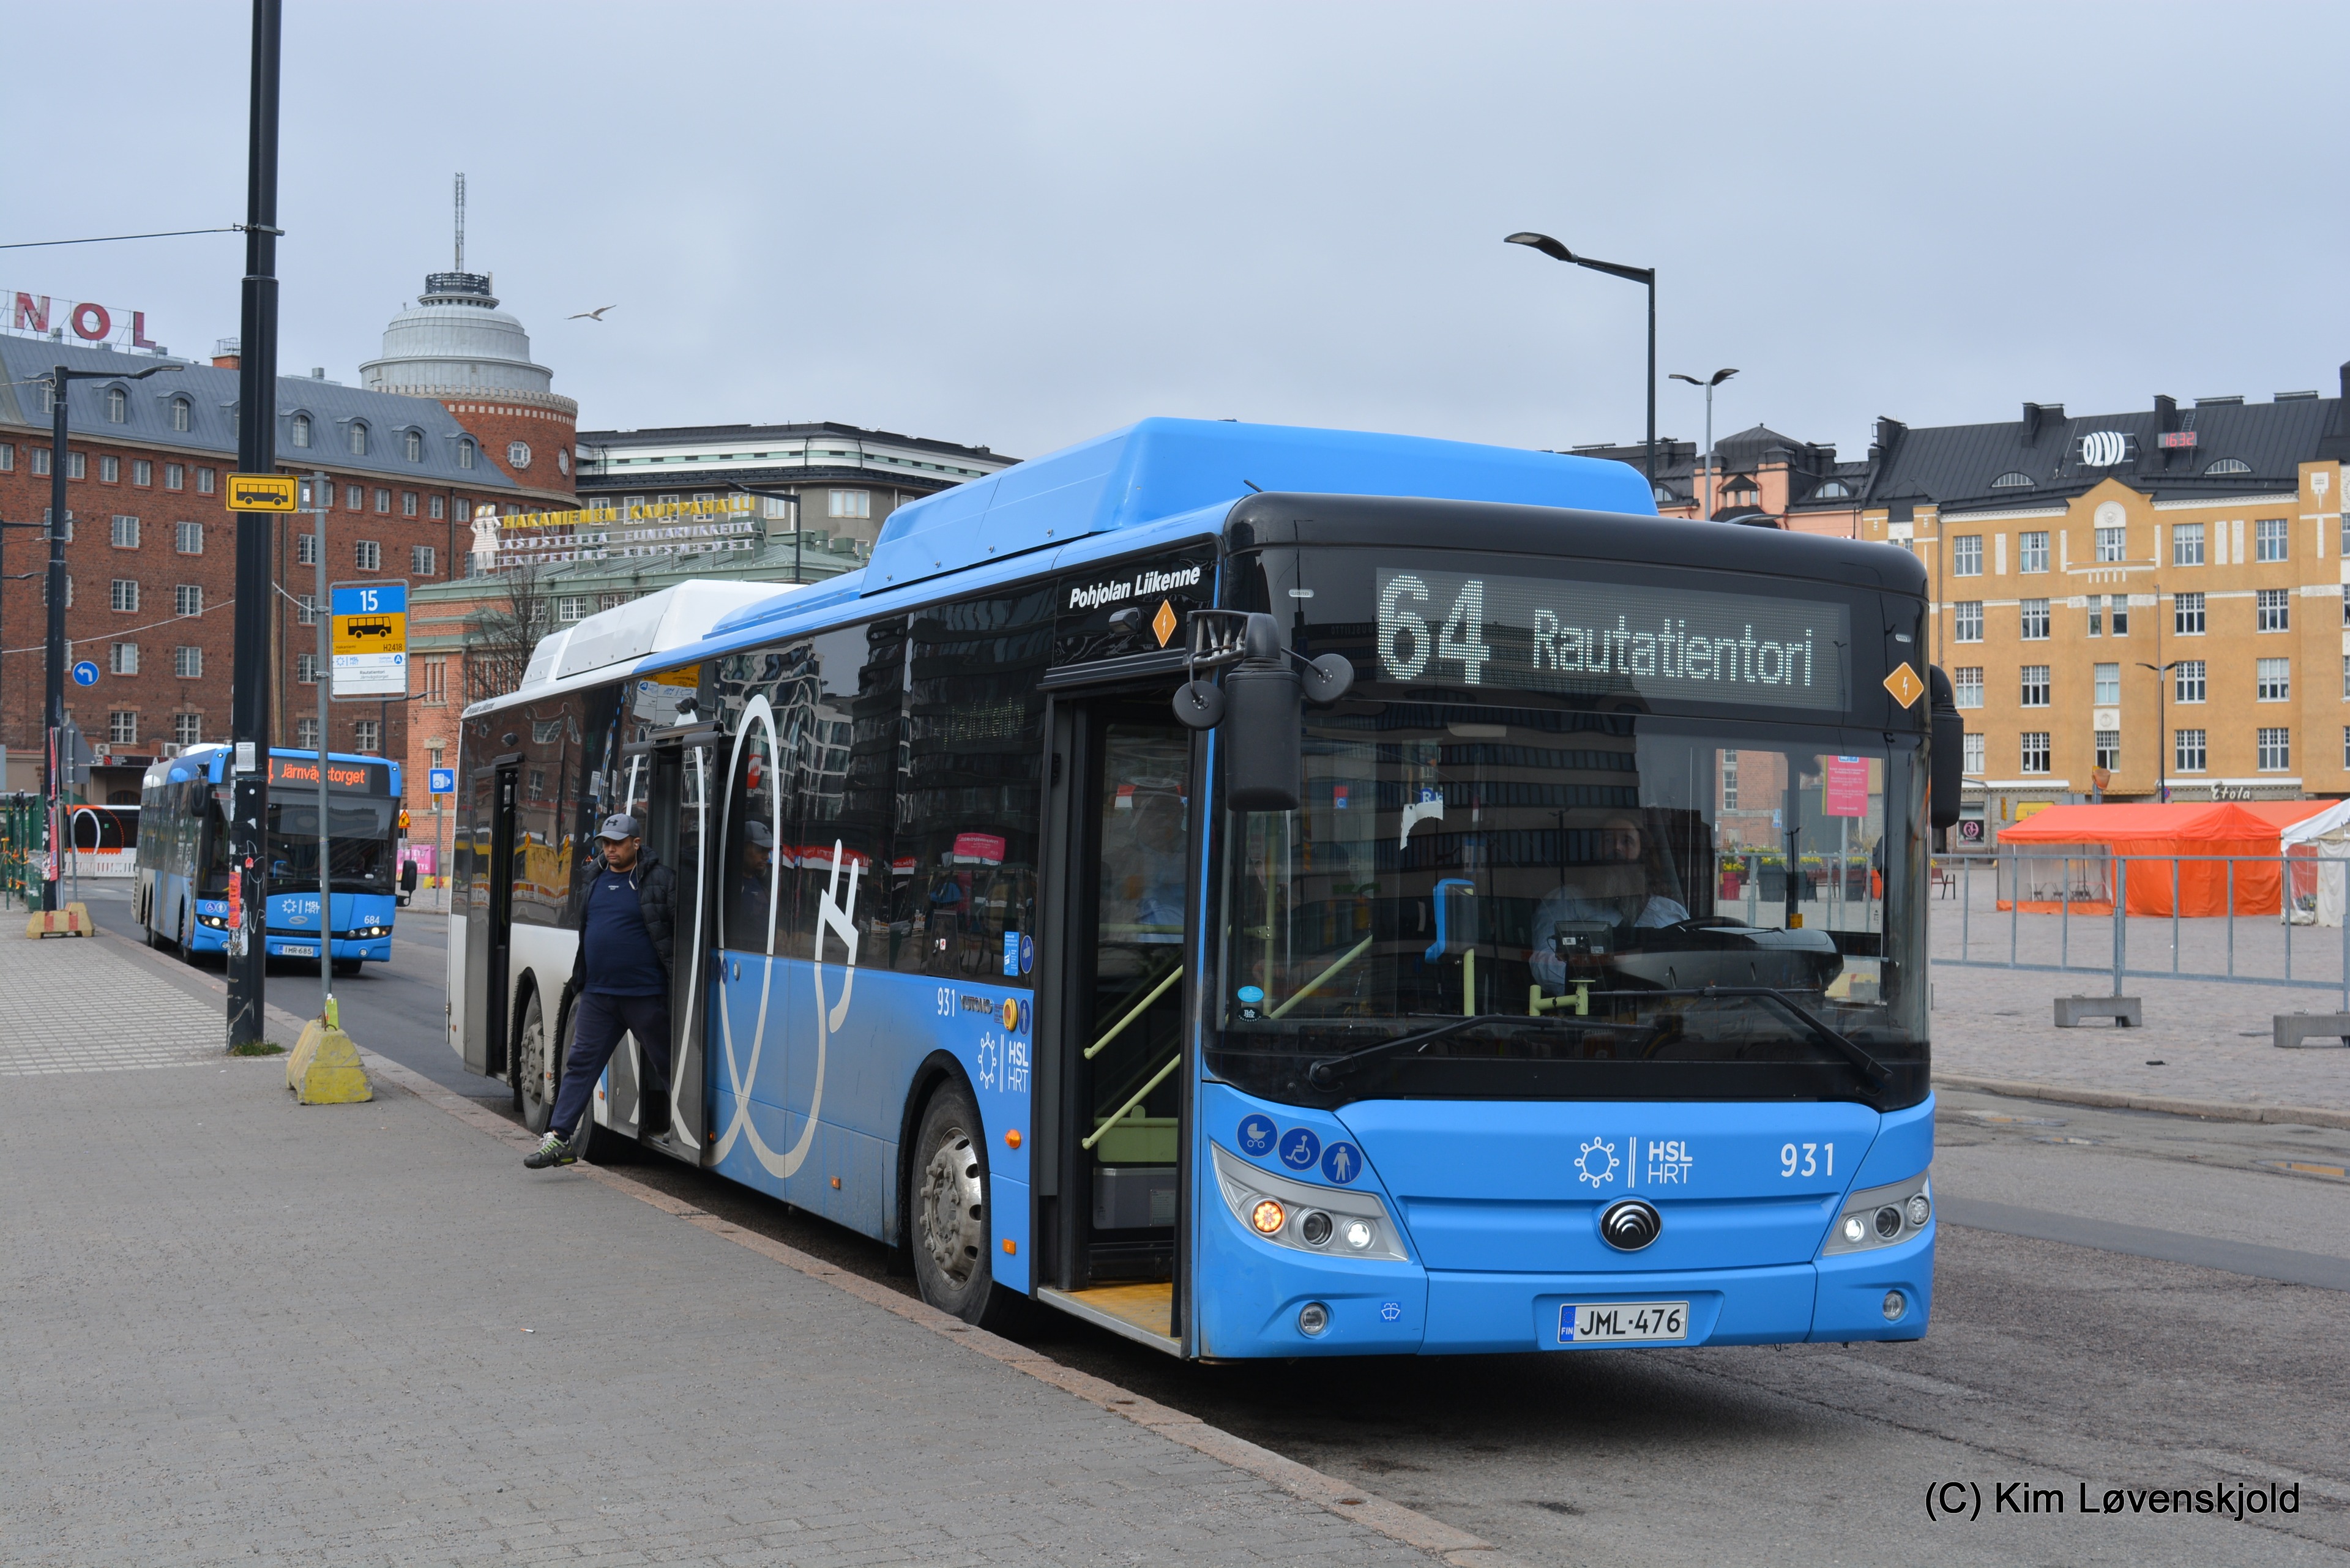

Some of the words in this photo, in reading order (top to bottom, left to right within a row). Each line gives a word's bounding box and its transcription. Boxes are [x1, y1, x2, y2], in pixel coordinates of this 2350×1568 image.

[2083, 431, 2125, 466] OLVI
[504, 507, 616, 529] HAKANIEMEN
[630, 496, 755, 519] KAUPPAHALLI
[360, 589, 378, 611] 15
[1069, 581, 1131, 609] Pohjolan
[1134, 567, 1201, 596] Liikenne
[1378, 575, 1490, 684] 64
[1534, 610, 1812, 686] Rautatientori
[383, 643, 403, 652] H2418
[281, 763, 365, 786] Järnvätorget
[2210, 780, 2251, 801] Etola
[364, 915, 381, 925] 684
[938, 987, 955, 1017] 931
[1009, 1040, 1029, 1067] HSL
[1008, 1066, 1029, 1093] HRT
[1649, 1141, 1693, 1162] HSL
[1780, 1142, 1833, 1178] 931
[1648, 1163, 1693, 1184] HRT
[1561, 1326, 1574, 1335] FIN
